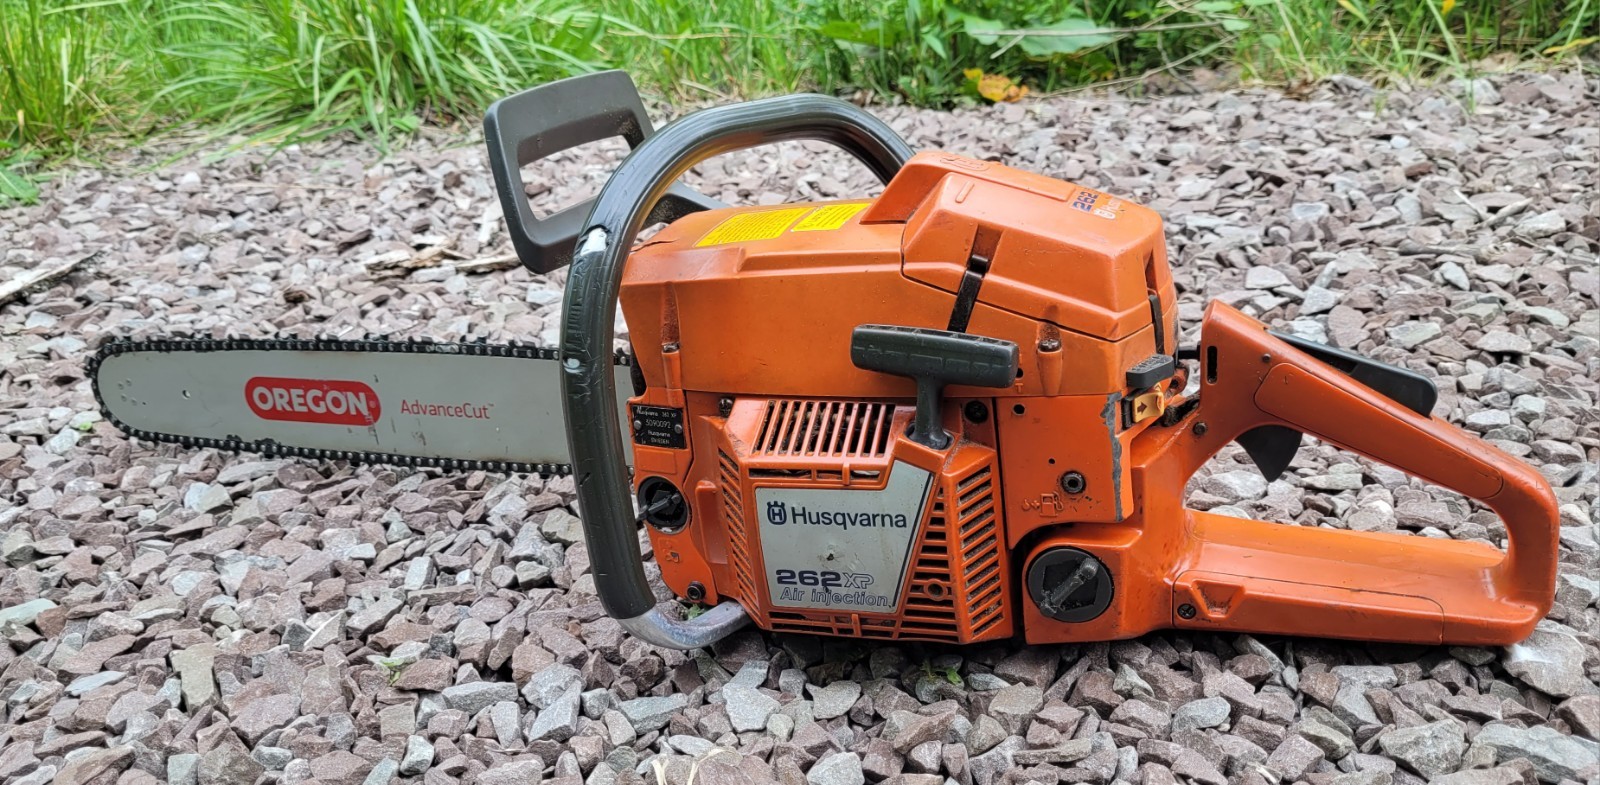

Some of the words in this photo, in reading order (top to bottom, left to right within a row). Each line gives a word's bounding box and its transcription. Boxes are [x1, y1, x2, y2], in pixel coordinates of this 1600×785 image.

[1073, 190, 1099, 212] 262
[251, 385, 370, 416] OREGON
[791, 506, 907, 530] Husqvarna
[780, 587, 805, 601] Air
[811, 588, 889, 607] injection
